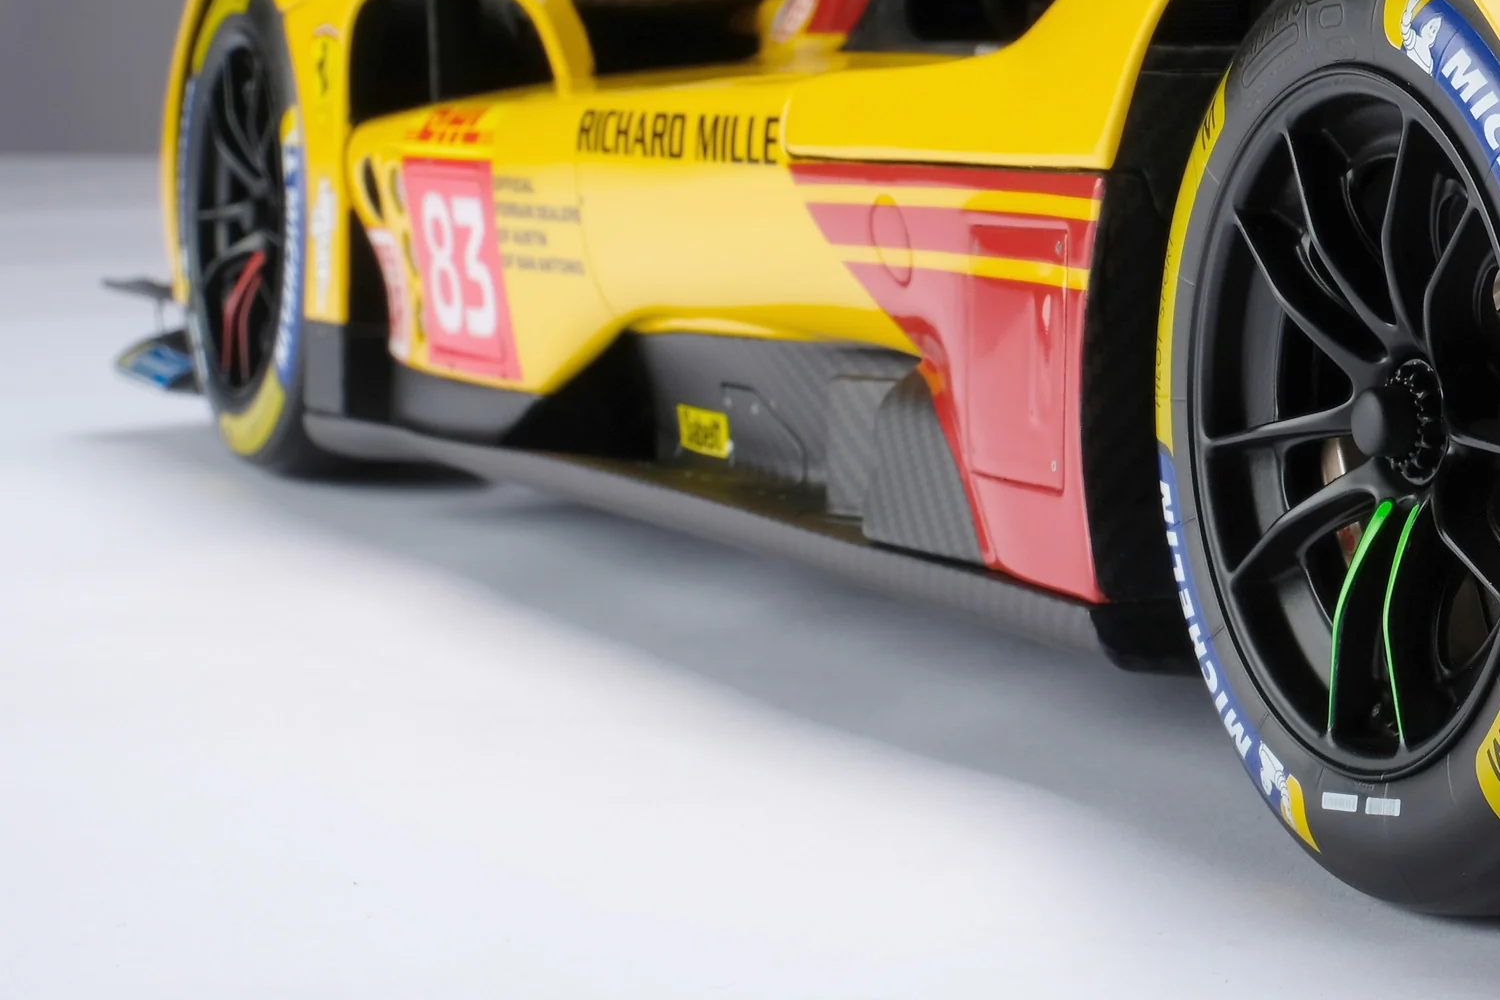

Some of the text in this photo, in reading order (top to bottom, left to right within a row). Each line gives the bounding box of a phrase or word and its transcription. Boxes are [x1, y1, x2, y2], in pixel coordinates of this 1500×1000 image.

[577, 108, 781, 165] RICHARD MILLE
[422, 191, 497, 337] 83
